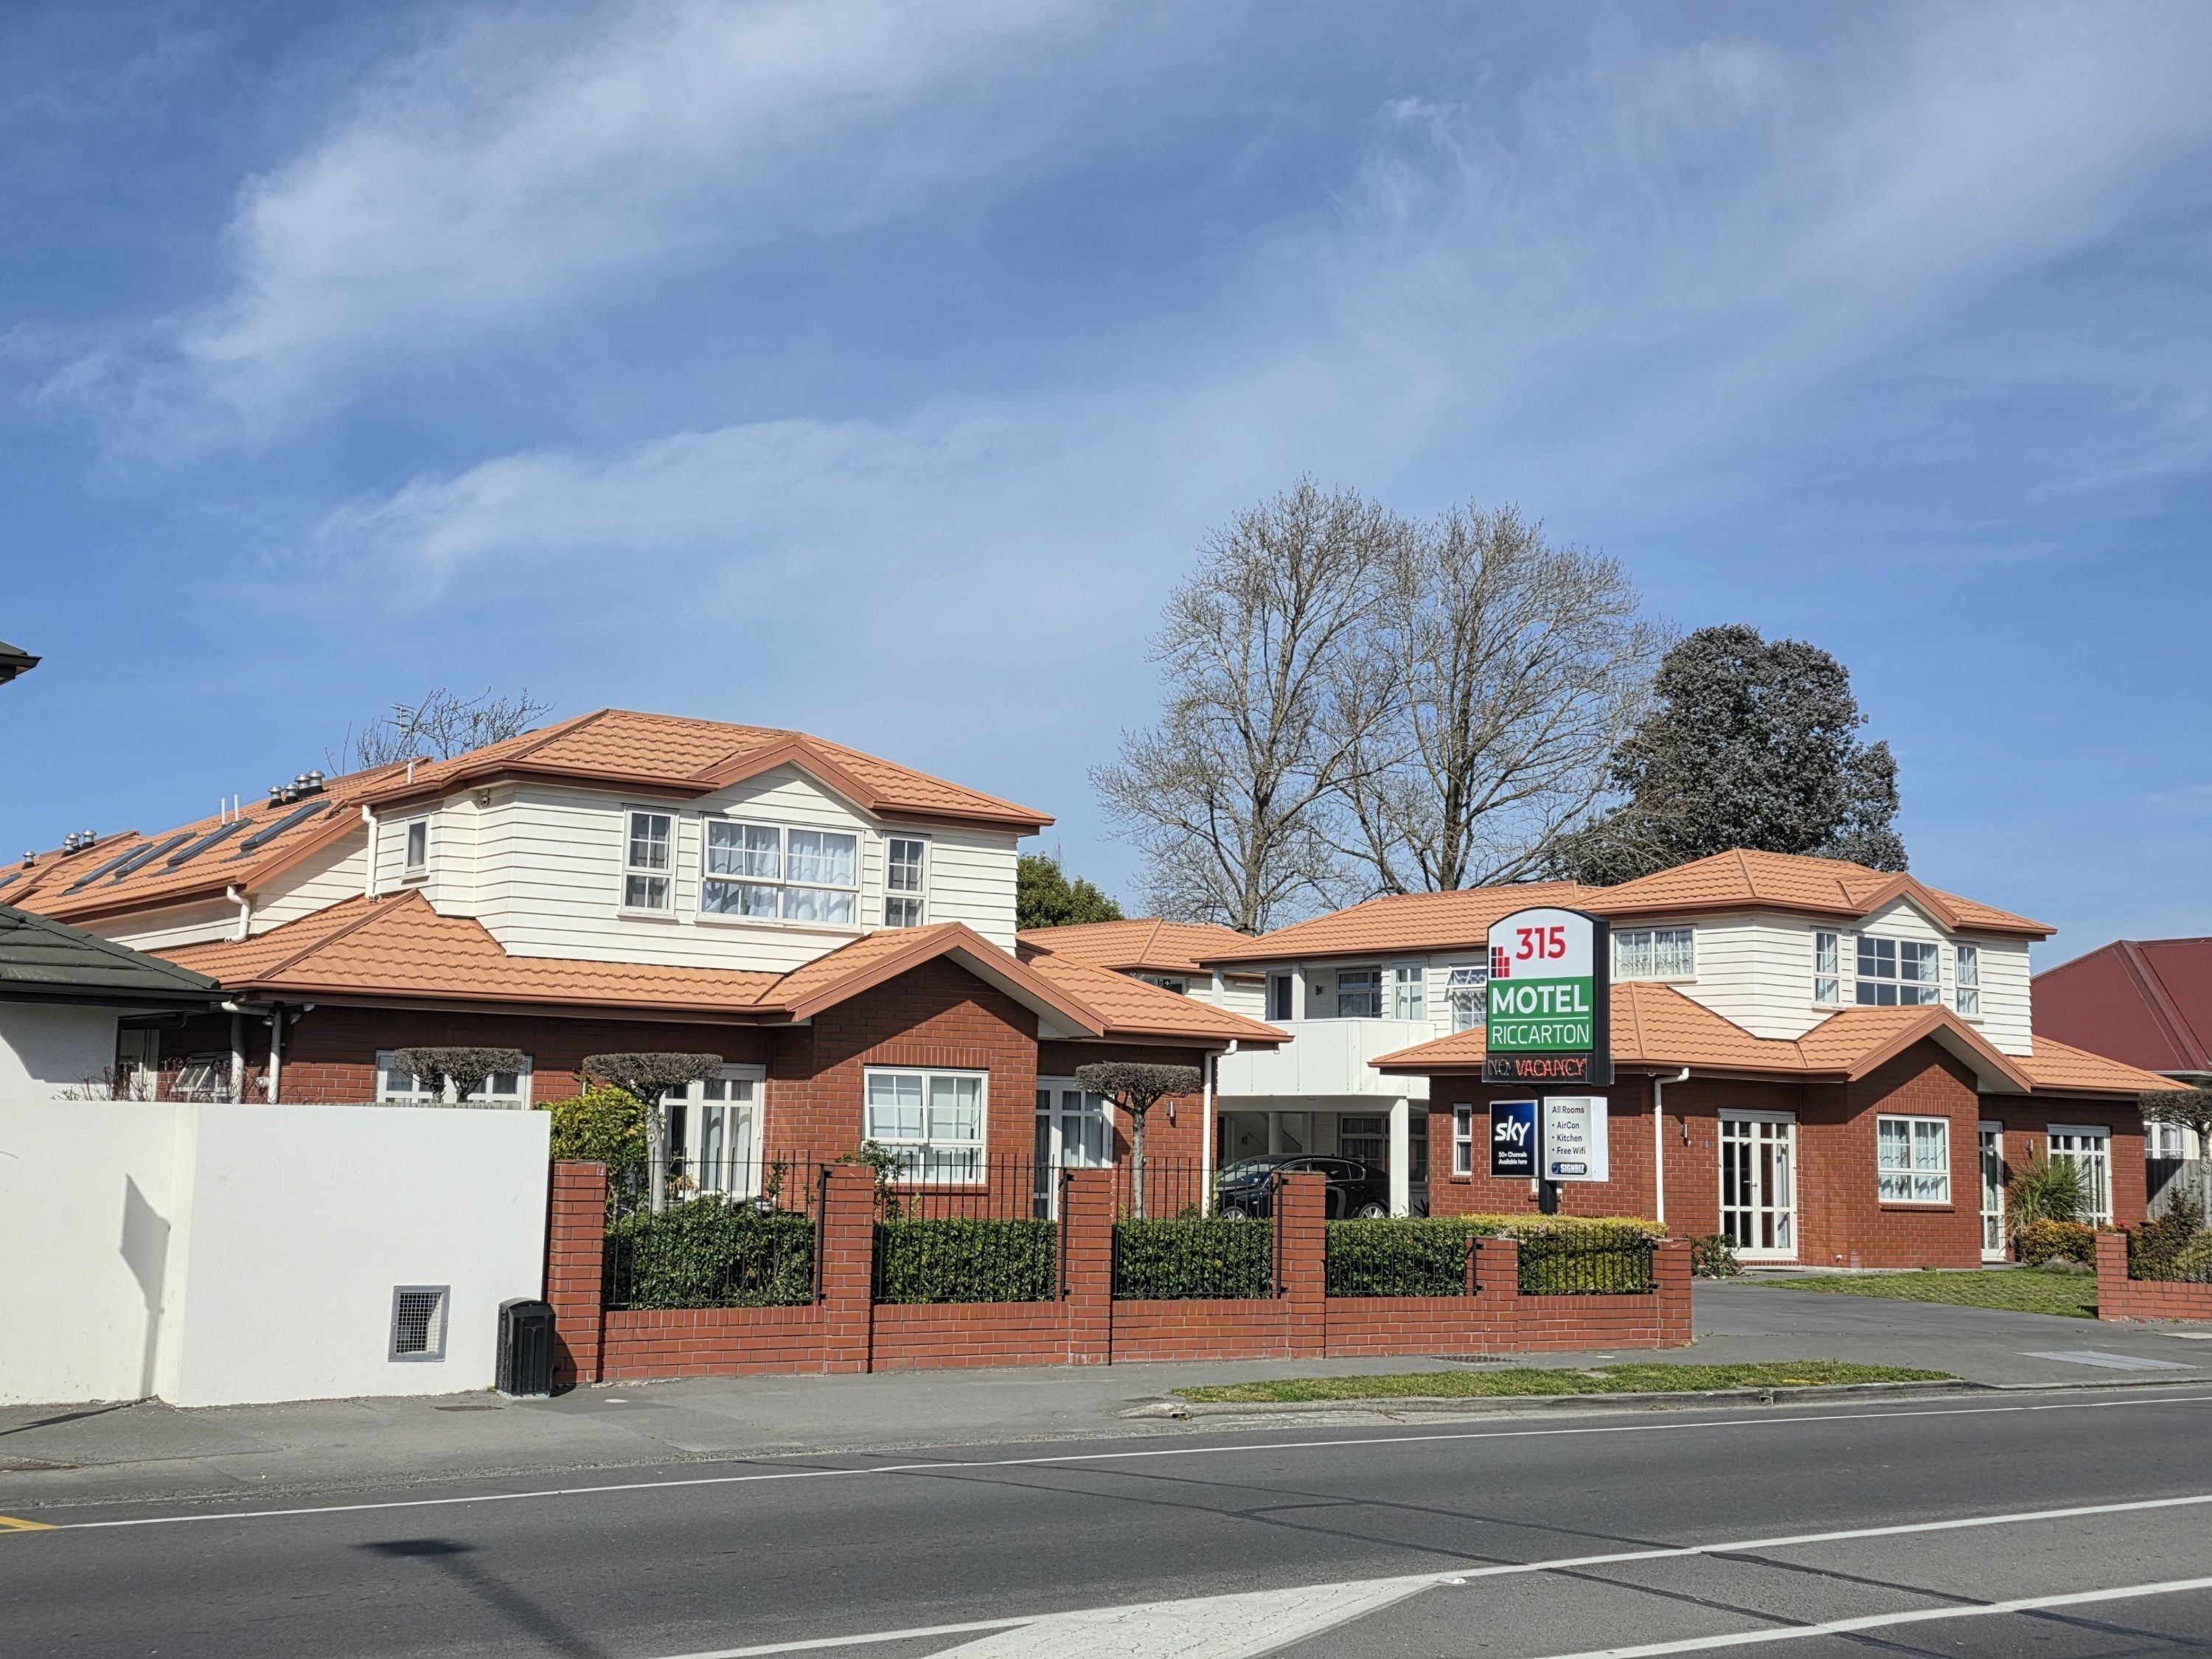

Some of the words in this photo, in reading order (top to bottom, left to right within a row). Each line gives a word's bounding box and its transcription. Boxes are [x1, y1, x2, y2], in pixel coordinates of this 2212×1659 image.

[1516, 926, 1565, 960] 315
[1492, 985, 1589, 1014] MOTEL
[1492, 1024, 1589, 1044] RICCARTON
[1488, 1059, 1511, 1076] NO
[1516, 1058, 1587, 1077] VACANCY
[1557, 1147, 1571, 1155] Free
[1573, 1147, 1586, 1155] Wifi
